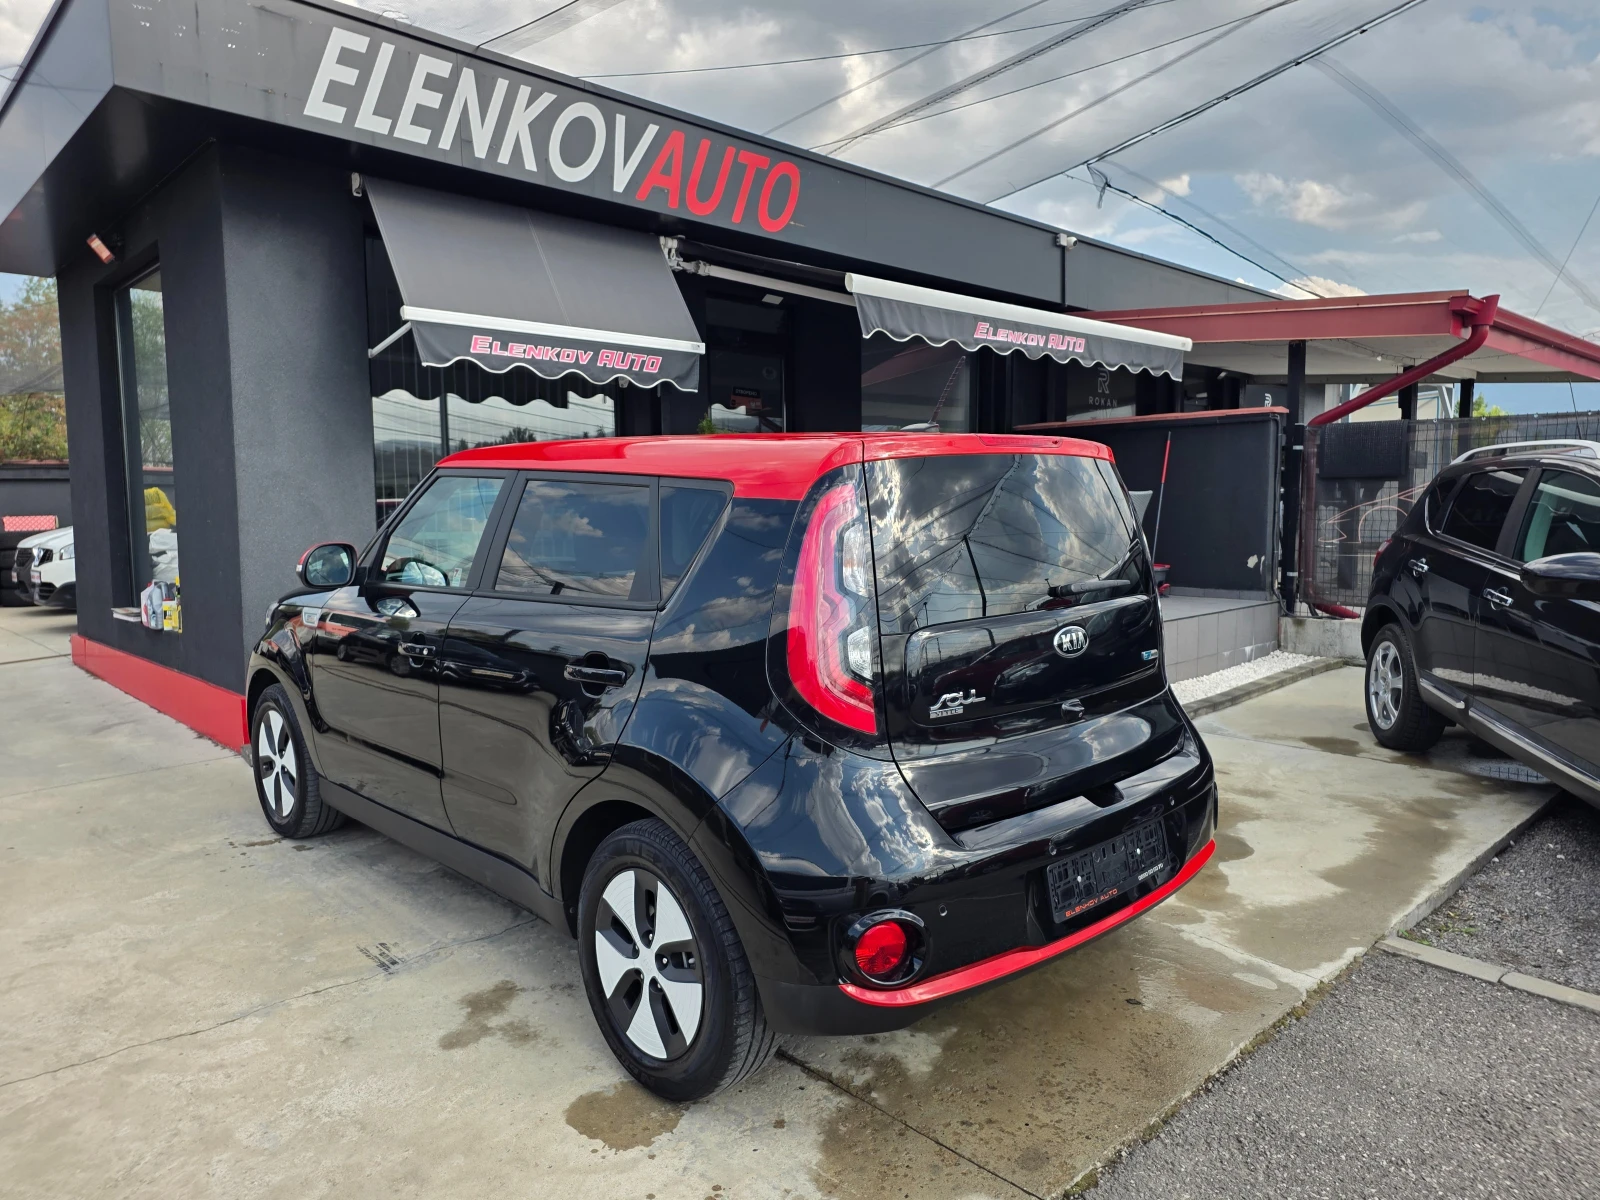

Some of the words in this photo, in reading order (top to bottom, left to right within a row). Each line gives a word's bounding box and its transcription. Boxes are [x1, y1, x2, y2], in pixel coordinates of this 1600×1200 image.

[973, 321, 1046, 347] ELENKOV
[1047, 333, 1086, 353] AUTO
[470, 334, 593, 364] ELENKOV
[597, 349, 662, 373] AUTO
[1088, 396, 1118, 408] ROKAN
[1061, 631, 1087, 652] KIA
[1100, 888, 1118, 901] AUTO
